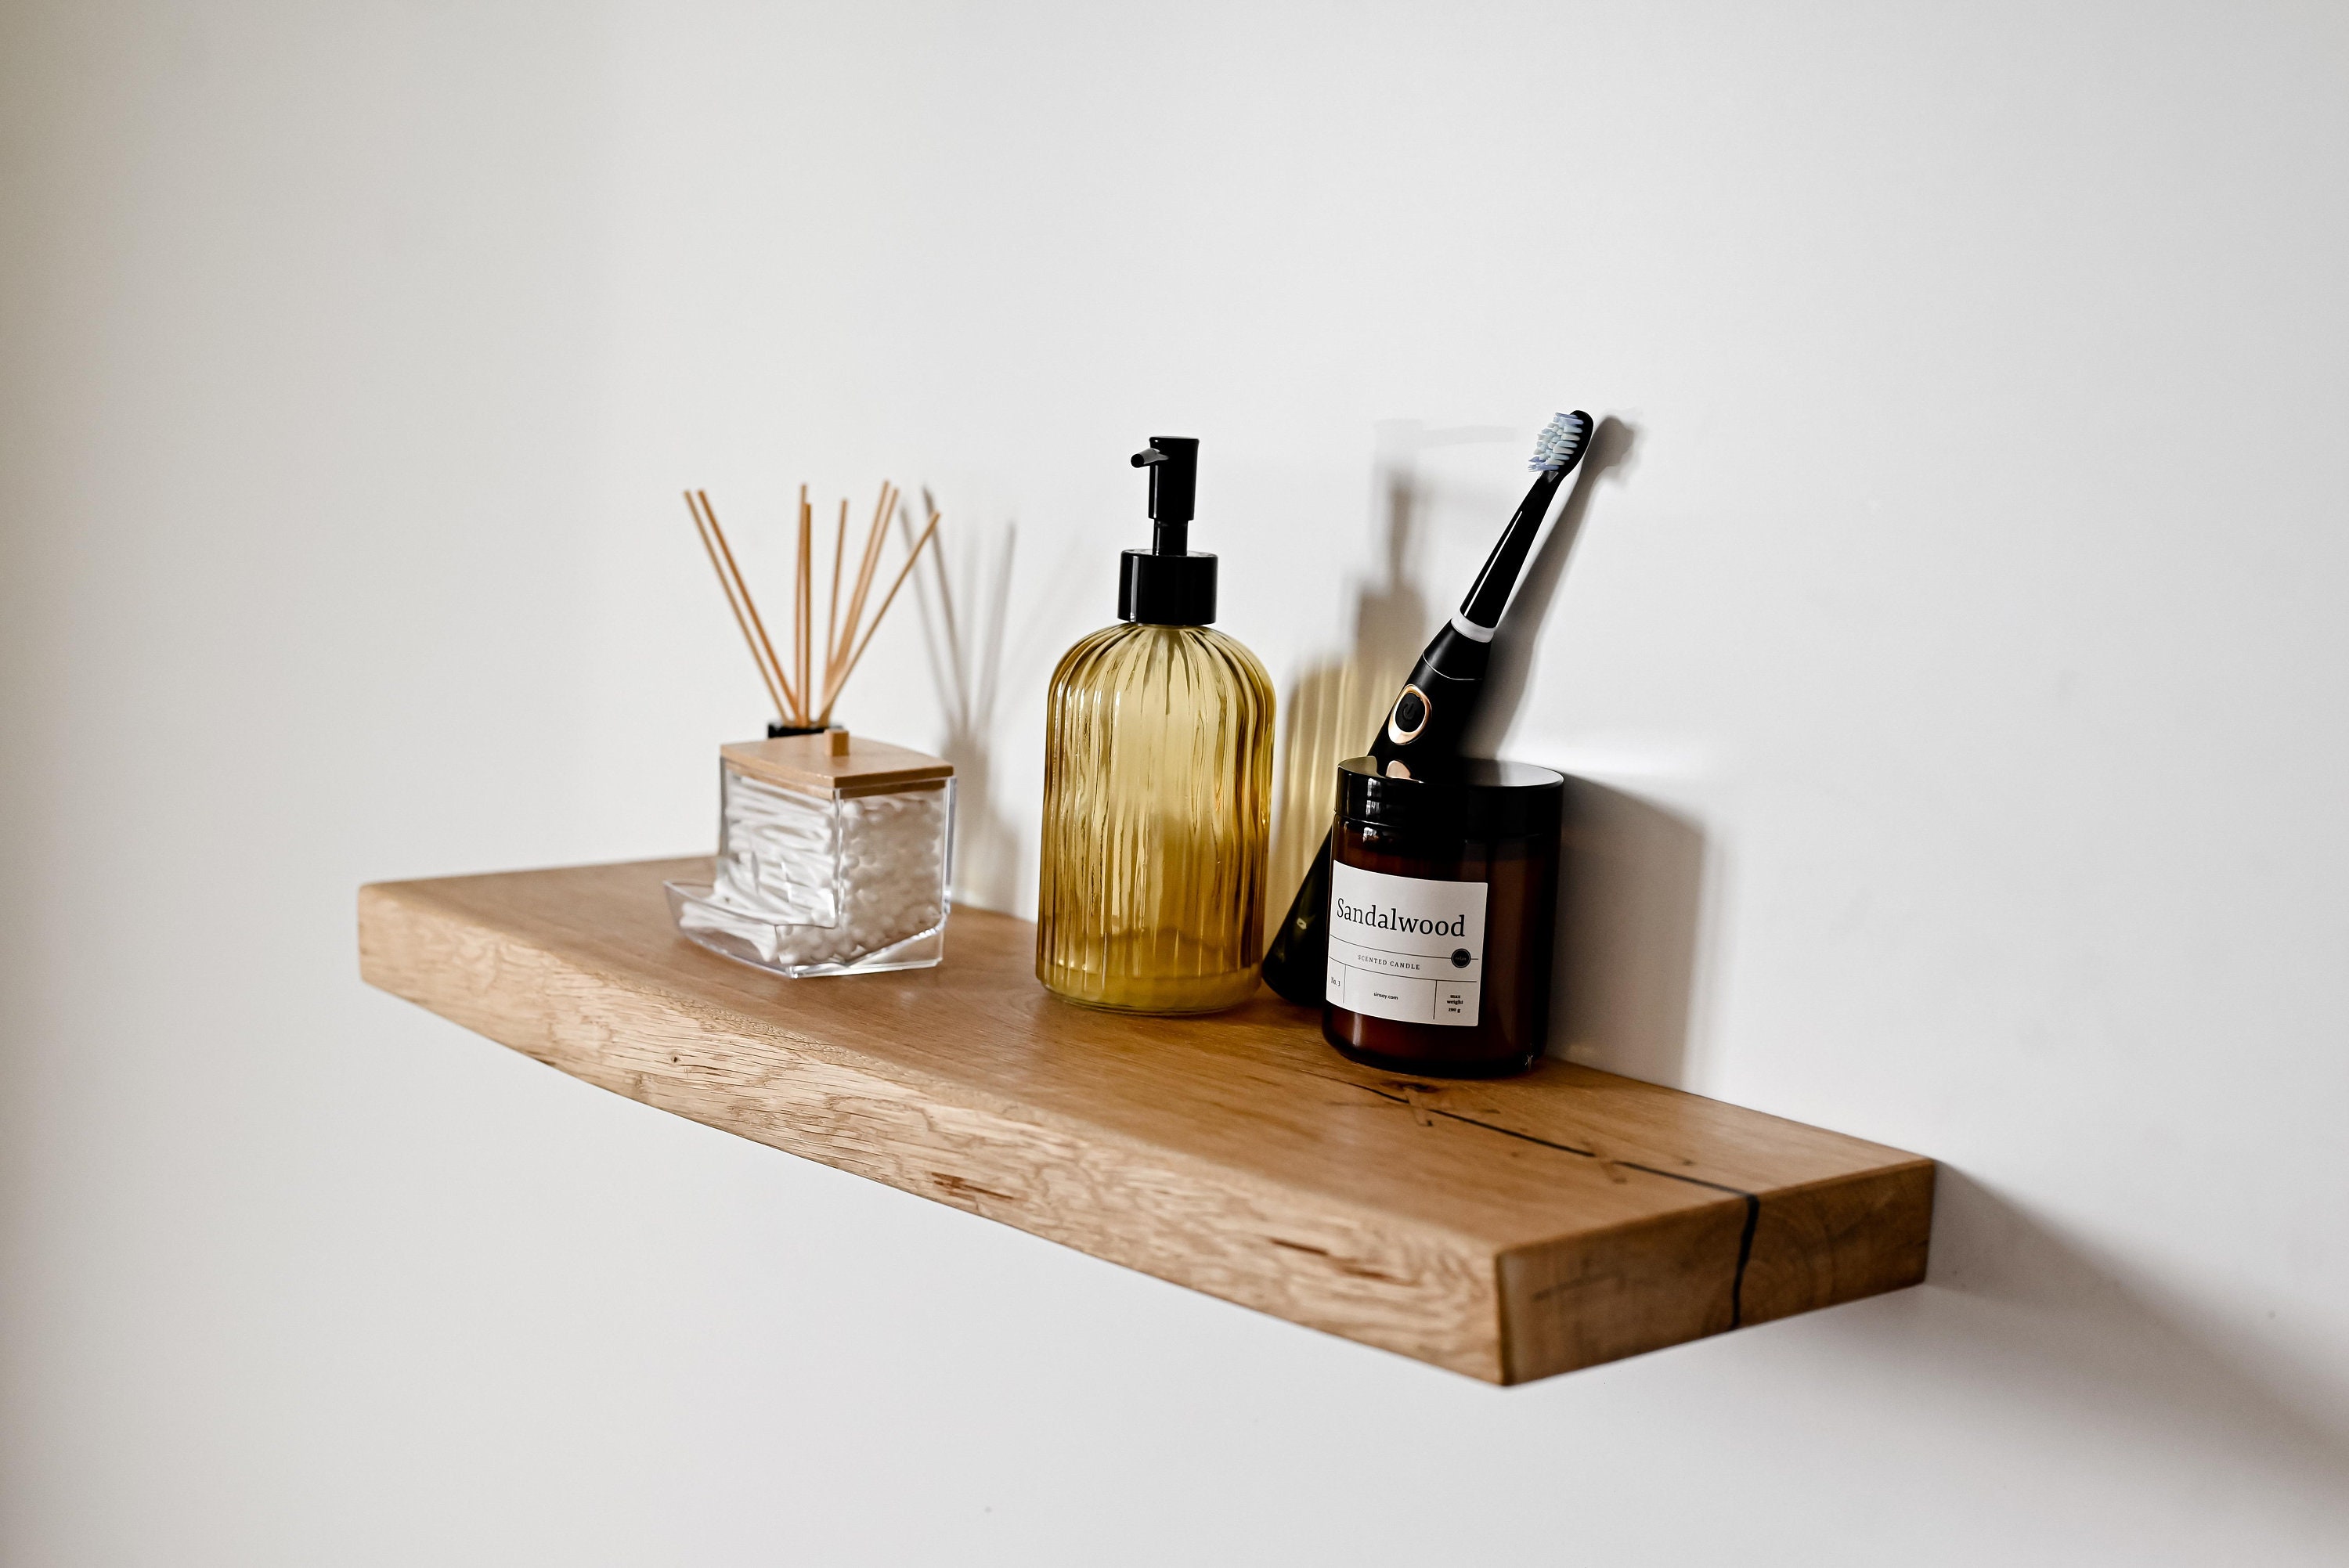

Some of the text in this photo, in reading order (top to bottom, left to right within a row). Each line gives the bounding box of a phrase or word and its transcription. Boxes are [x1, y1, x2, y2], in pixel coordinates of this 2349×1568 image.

[1337, 898, 1465, 937] Sandalwood
[1358, 954, 1420, 970] SCENTED CANDLE
[1373, 992, 1398, 1000] sinsay.com
